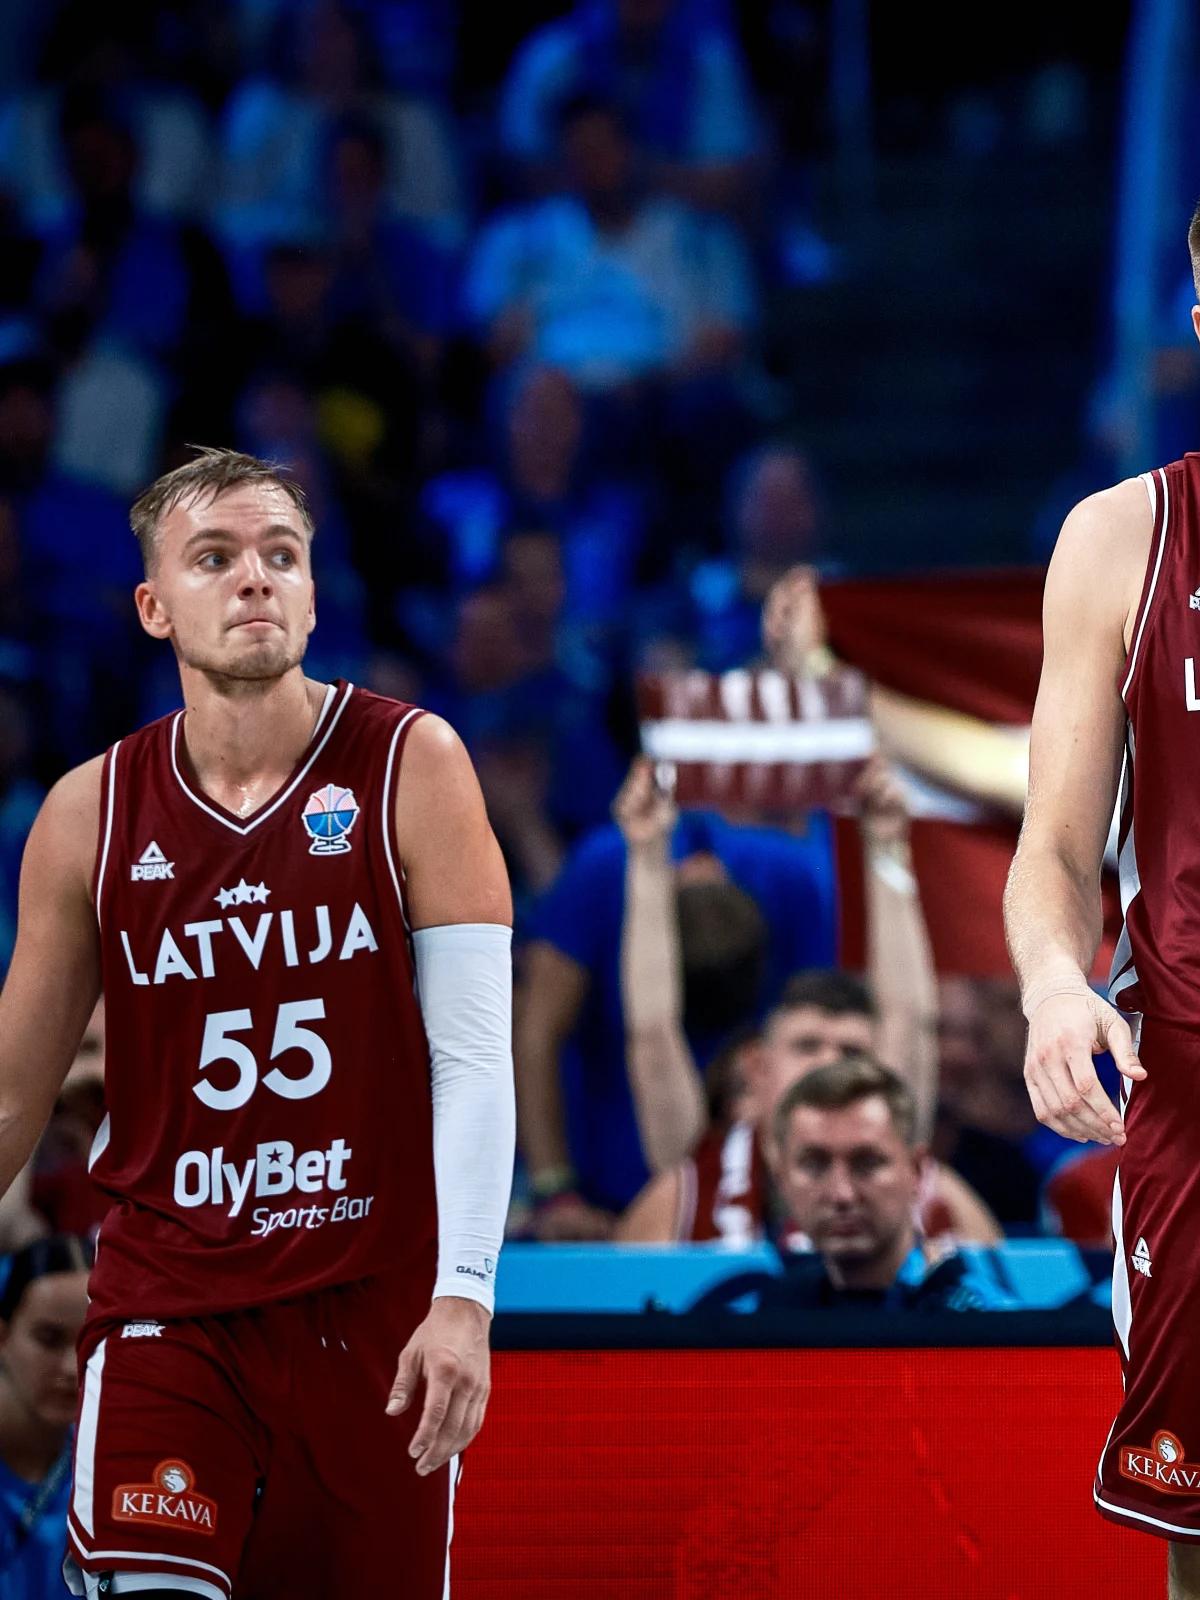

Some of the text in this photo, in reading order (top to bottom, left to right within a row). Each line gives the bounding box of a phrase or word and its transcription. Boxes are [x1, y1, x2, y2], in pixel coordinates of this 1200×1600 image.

[131, 862, 175, 881] PEAK
[120, 902, 379, 985] LATVIJA
[192, 998, 333, 1111] 55
[173, 1138, 352, 1218] OlyBet
[250, 1196, 374, 1238] Sports Bar
[120, 1323, 166, 1339] PEAK
[121, 1492, 213, 1528] ĶEKAVA
